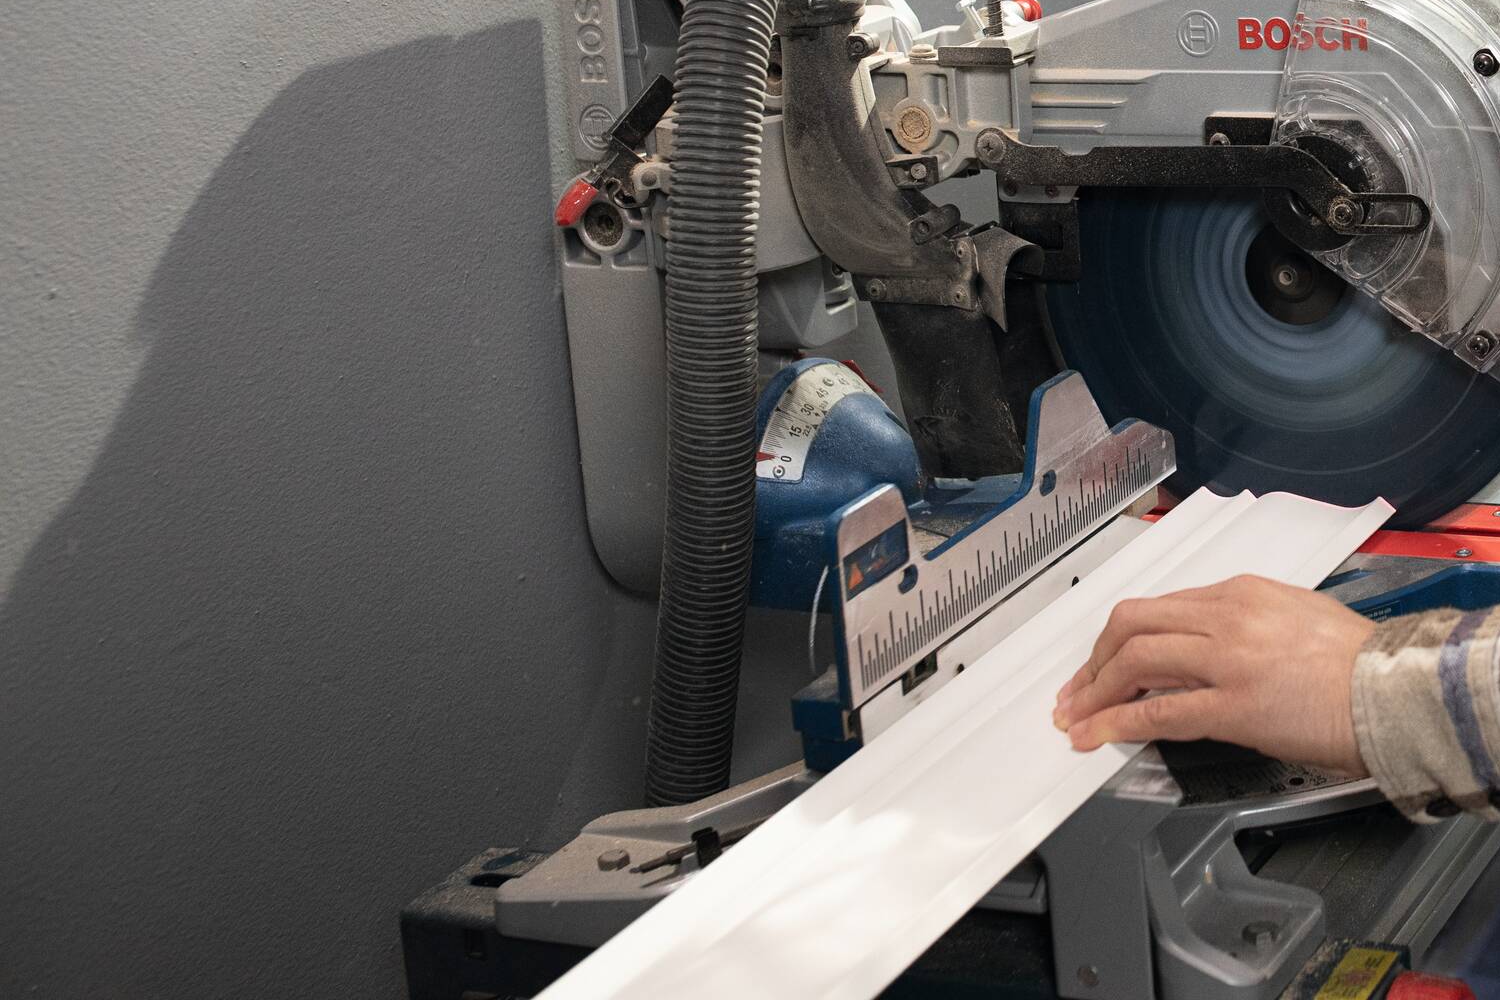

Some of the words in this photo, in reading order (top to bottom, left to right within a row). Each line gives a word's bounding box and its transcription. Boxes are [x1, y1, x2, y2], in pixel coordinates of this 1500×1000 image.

[1237, 13, 1369, 51] BOSCH
[816, 387, 829, 399] 45
[801, 403, 815, 416] 30
[788, 425, 803, 437] 15
[780, 455, 792, 463] 0
